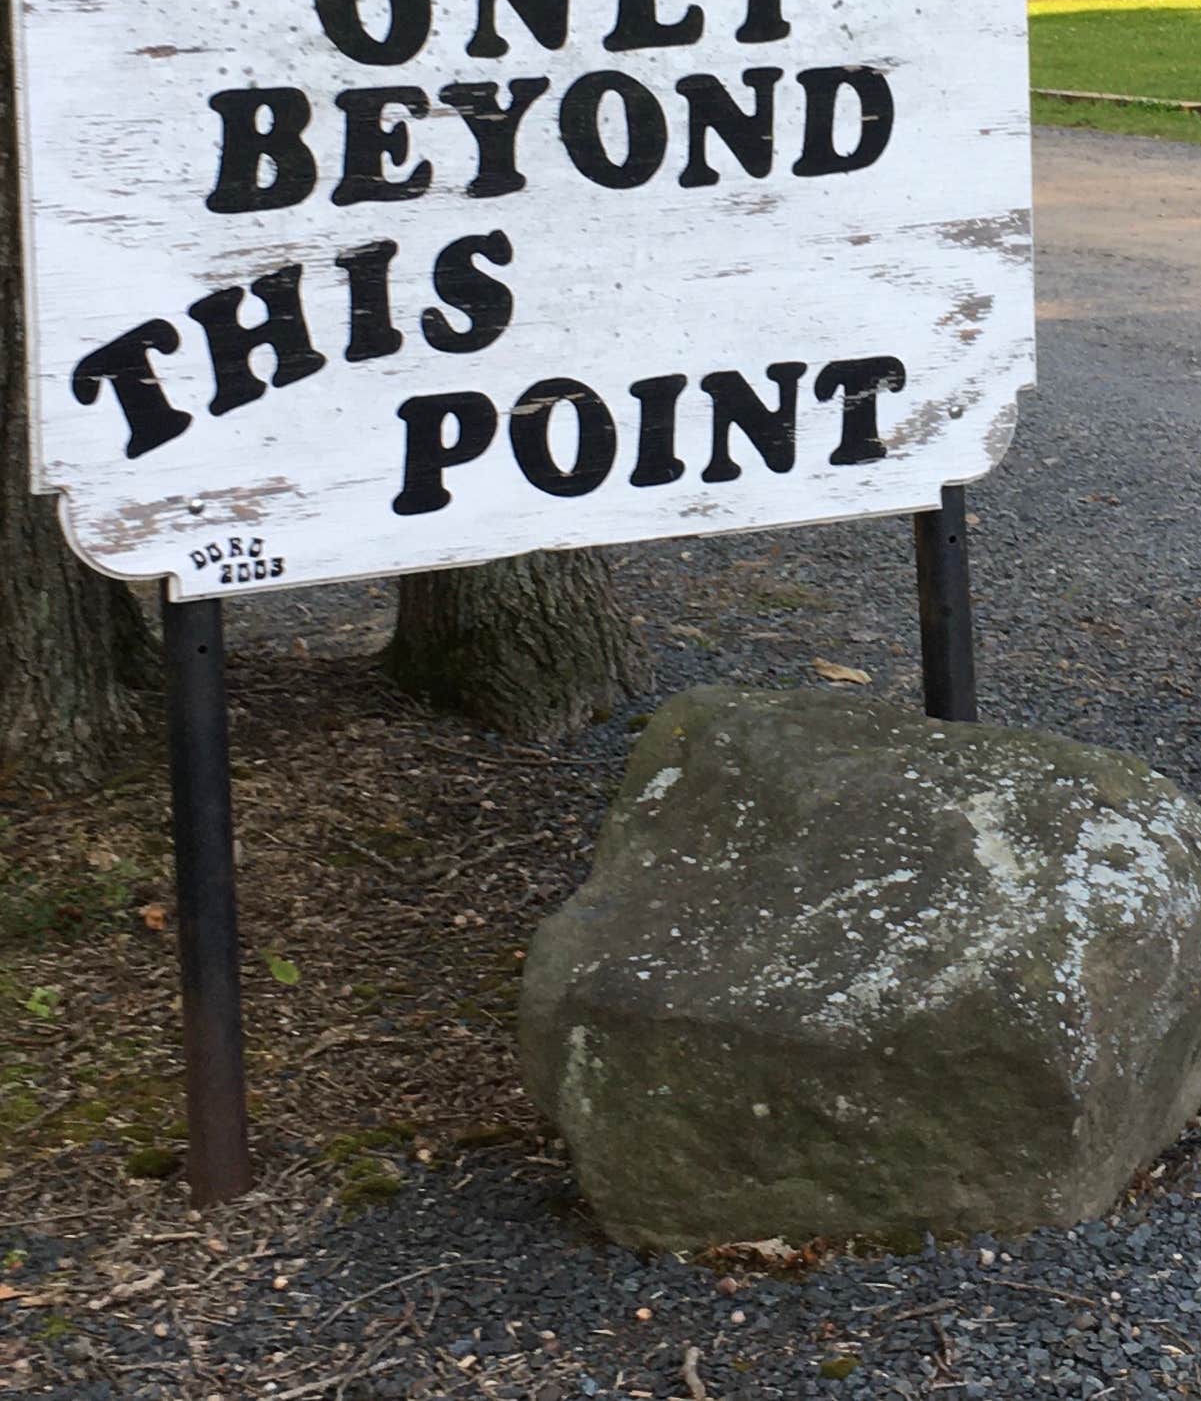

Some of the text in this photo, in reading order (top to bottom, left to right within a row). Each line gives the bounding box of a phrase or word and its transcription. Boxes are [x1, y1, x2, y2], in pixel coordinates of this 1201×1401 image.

[206, 66, 896, 213] BEYOND
[71, 229, 514, 459] THIS
[391, 355, 907, 516] POINT
[221, 558, 285, 584] 2003
